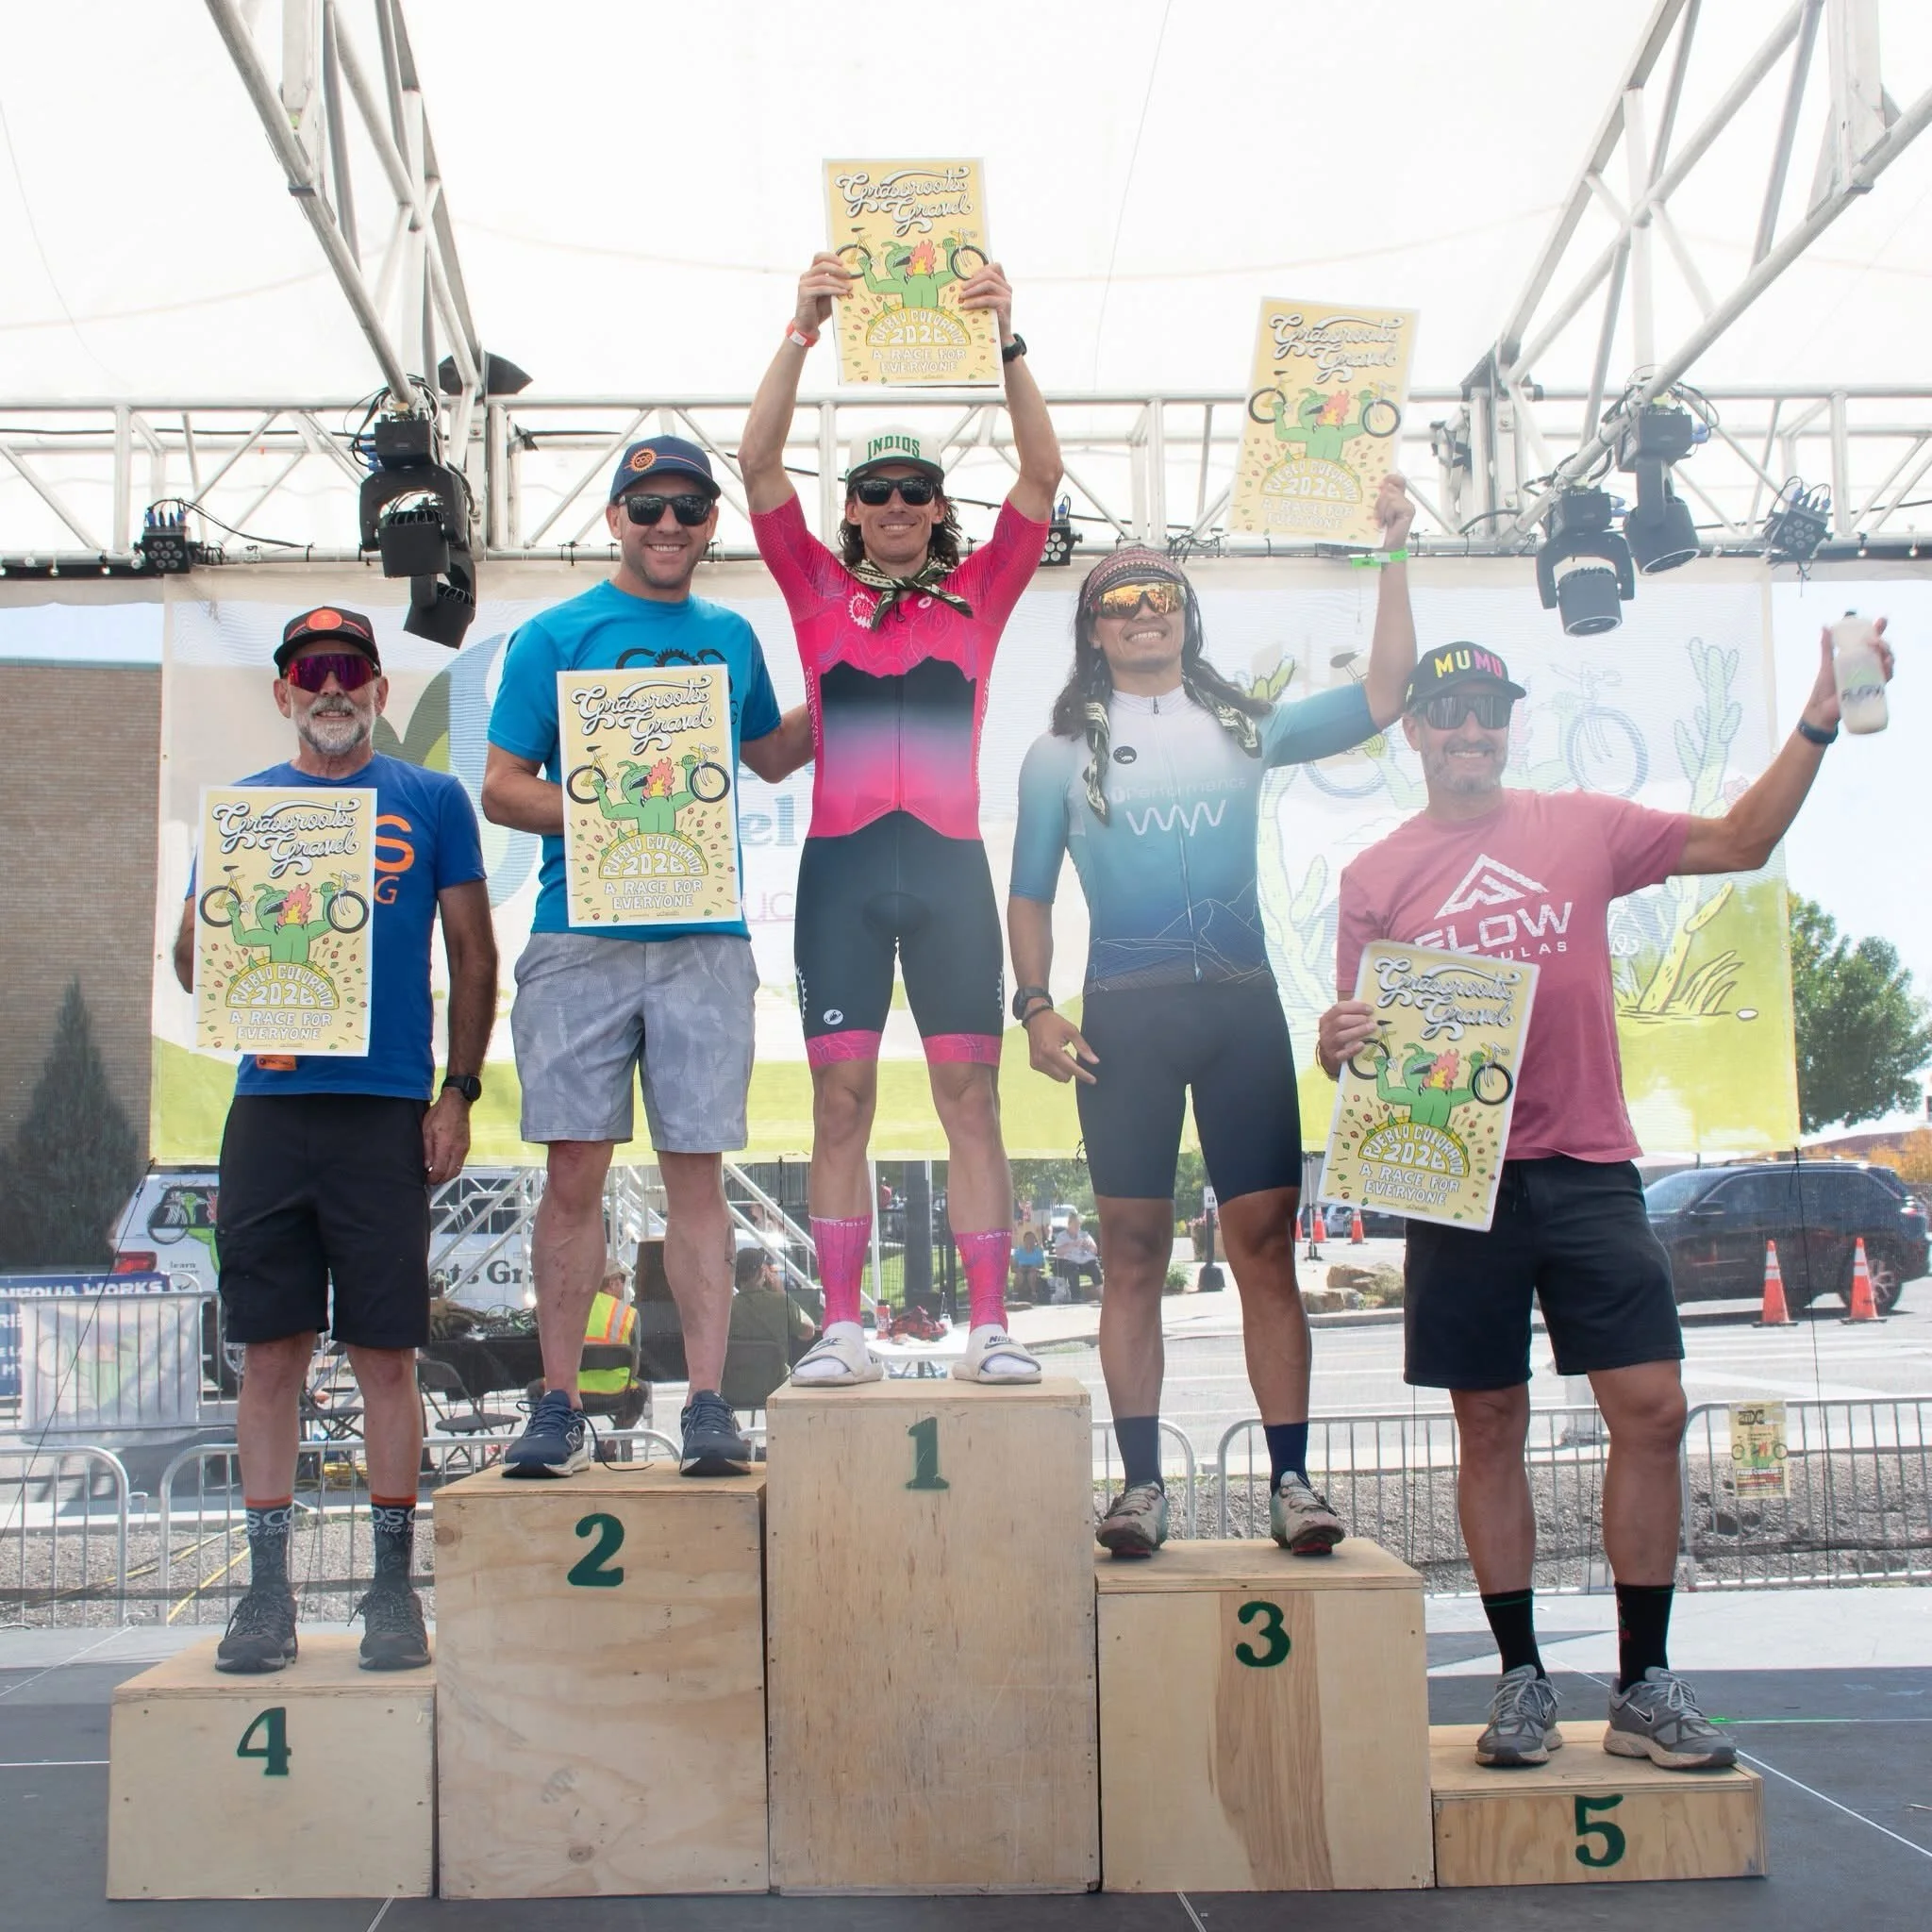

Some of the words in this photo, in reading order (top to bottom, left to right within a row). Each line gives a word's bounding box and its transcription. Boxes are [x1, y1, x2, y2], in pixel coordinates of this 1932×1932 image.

[835, 166, 971, 218] Grassroots
[880, 192, 974, 237] Gravel
[873, 348, 884, 359] A
[891, 348, 932, 359] RACE
[939, 347, 967, 359] FOR
[880, 361, 958, 374] EVERYONE
[1308, 342, 1399, 384] Gravel
[867, 436, 920, 460] INDIOS
[1261, 498, 1274, 509] A
[1281, 498, 1319, 515] RACE
[1326, 505, 1354, 517] FOR
[1267, 512, 1342, 528] EVERYONE
[1434, 649, 1503, 678] MUMU
[571, 674, 713, 736] Grassroots
[618, 704, 716, 755] Gravel
[212, 798, 361, 854] Grassroots
[258, 828, 361, 879] Gravel
[604, 838, 642, 875] PUEBLO
[646, 836, 704, 874] COLORADO
[605, 882, 617, 895] A
[624, 880, 667, 894] RACE
[674, 878, 703, 893] FOR
[612, 894, 694, 910] EVERYONE
[1414, 901, 1574, 955] FLOW
[230, 966, 274, 1004] PUEBLO
[277, 965, 335, 1008] COLORADO
[1374, 957, 1522, 1008] Grassroots
[229, 1010, 242, 1024] A
[250, 1010, 295, 1025] RACE
[302, 1012, 332, 1026] FOR
[236, 1026, 321, 1041] EVERYONE
[1415, 994, 1513, 1041] Gravel
[1363, 1125, 1409, 1158] PUEBLO
[1414, 1125, 1465, 1175] COLORADO
[1359, 1162, 1373, 1177] A
[1379, 1165, 1424, 1187] RACE
[1430, 1175, 1460, 1192] FOR
[1364, 1179, 1447, 1205] EVERYONE
[83, 1280, 164, 1294] WORKS
[905, 1416, 950, 1490] 1
[567, 1512, 625, 1587] 2
[1236, 1600, 1291, 1668] 3
[237, 1707, 291, 1774] 4
[1574, 1793, 1626, 1868] 5
